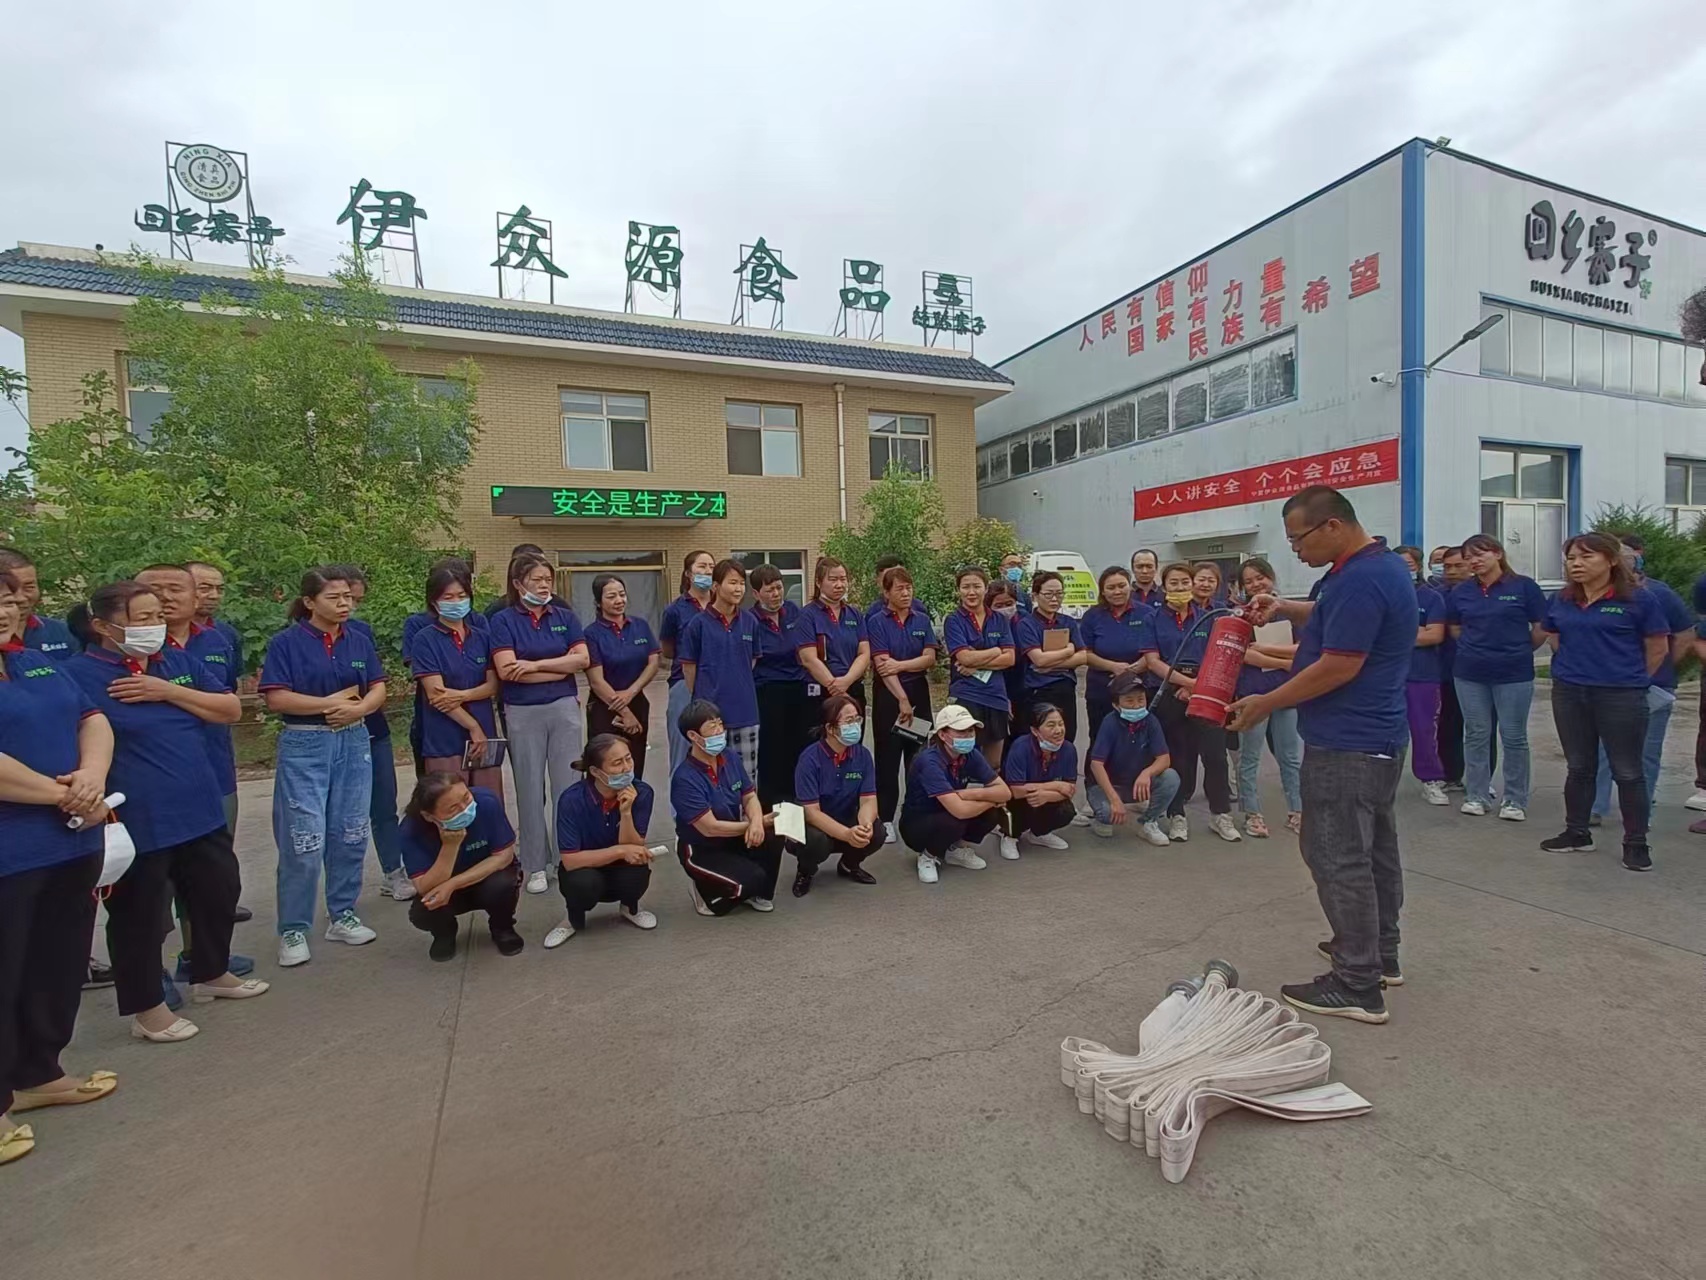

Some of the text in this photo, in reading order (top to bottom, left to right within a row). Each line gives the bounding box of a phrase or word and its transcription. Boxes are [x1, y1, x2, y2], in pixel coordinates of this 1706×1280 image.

[182, 148, 233, 168] NING XIA
[1079, 261, 1209, 352] 人民有信仰
[1127, 256, 1286, 357] 国家有力量
[1188, 252, 1382, 362] 民族有希望
[552, 489, 726, 517] 安全是生产之本
[1151, 451, 1382, 508] 人人讲安全 个个会应急
